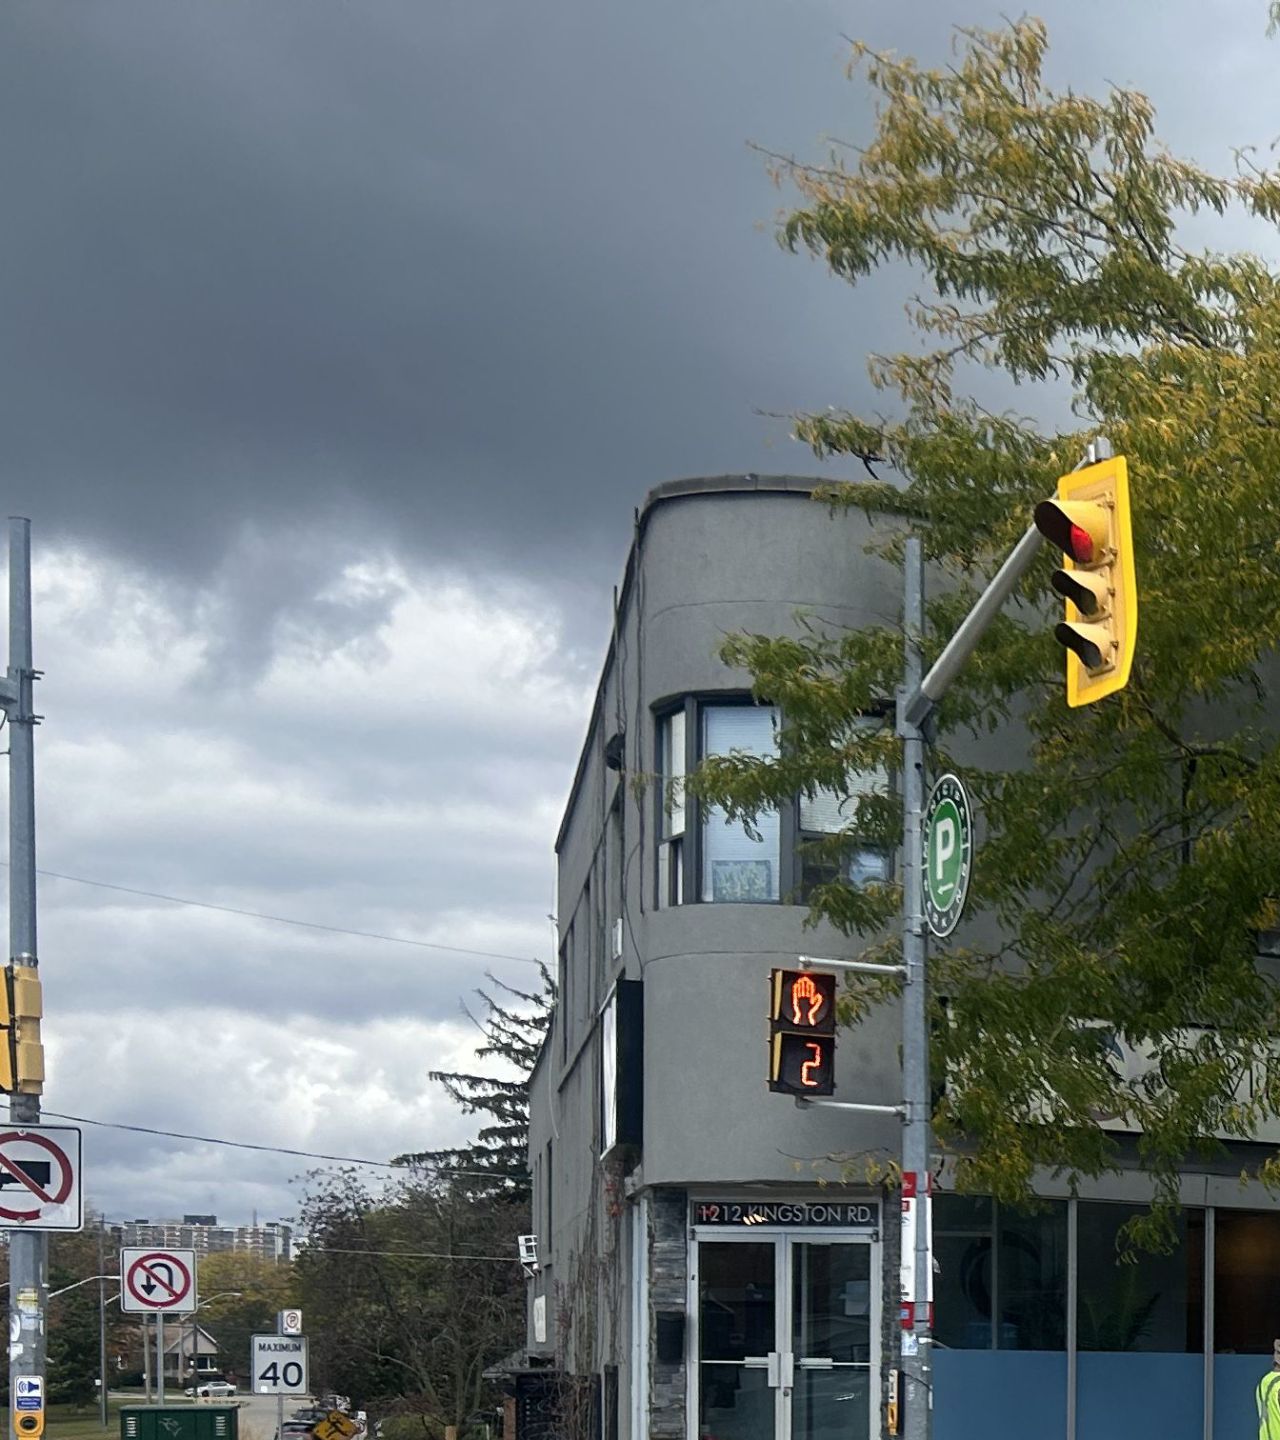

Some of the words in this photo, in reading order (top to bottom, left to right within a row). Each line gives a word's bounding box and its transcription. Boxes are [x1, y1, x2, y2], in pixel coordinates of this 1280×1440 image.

[801, 1042, 821, 1086] 2
[700, 1204, 742, 1223] 1212
[747, 1204, 841, 1223] KINGSTON
[847, 1204, 875, 1223] RD.
[258, 1343, 302, 1353] MAXIMUM
[258, 1361, 303, 1388] 40
